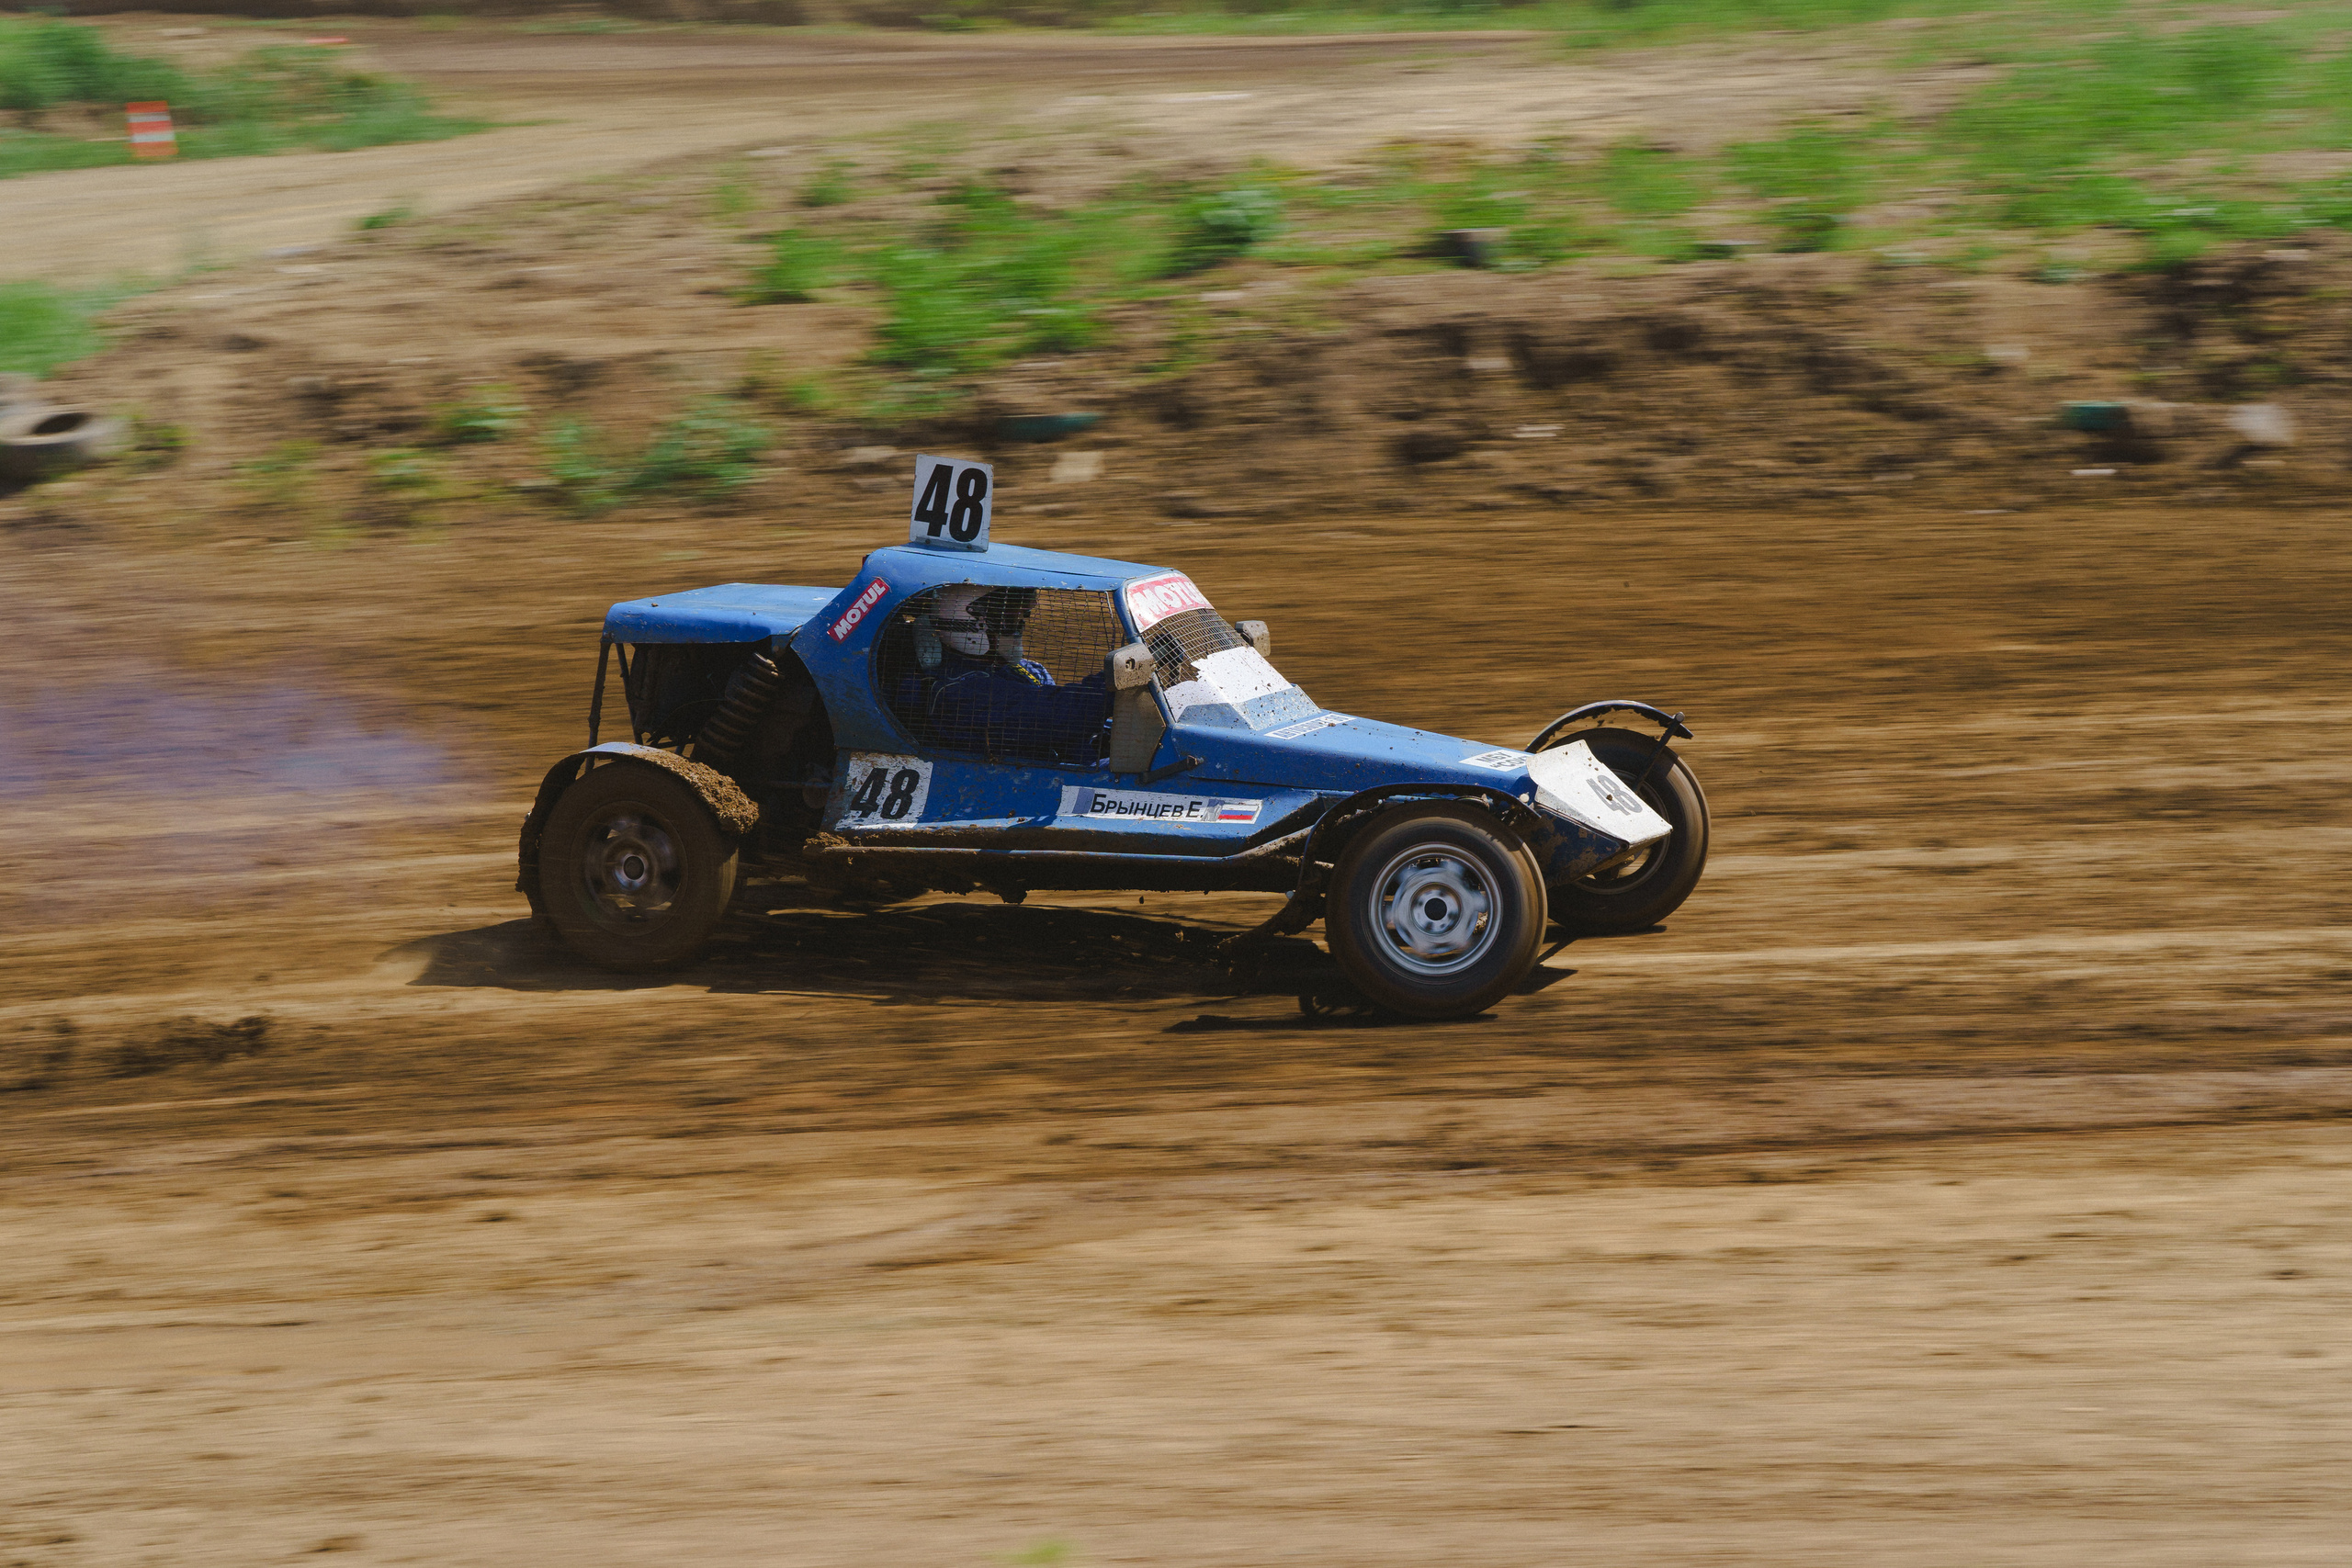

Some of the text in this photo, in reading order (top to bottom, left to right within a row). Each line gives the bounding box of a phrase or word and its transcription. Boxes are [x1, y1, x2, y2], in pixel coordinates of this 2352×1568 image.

[914, 464, 988, 542] 48
[833, 582, 886, 640] MOTUL
[1132, 581, 1207, 621] MOTU
[850, 767, 921, 819] 48
[1090, 794, 1183, 818] БРЫНЦЕВ
[1585, 774, 1643, 816] 48
